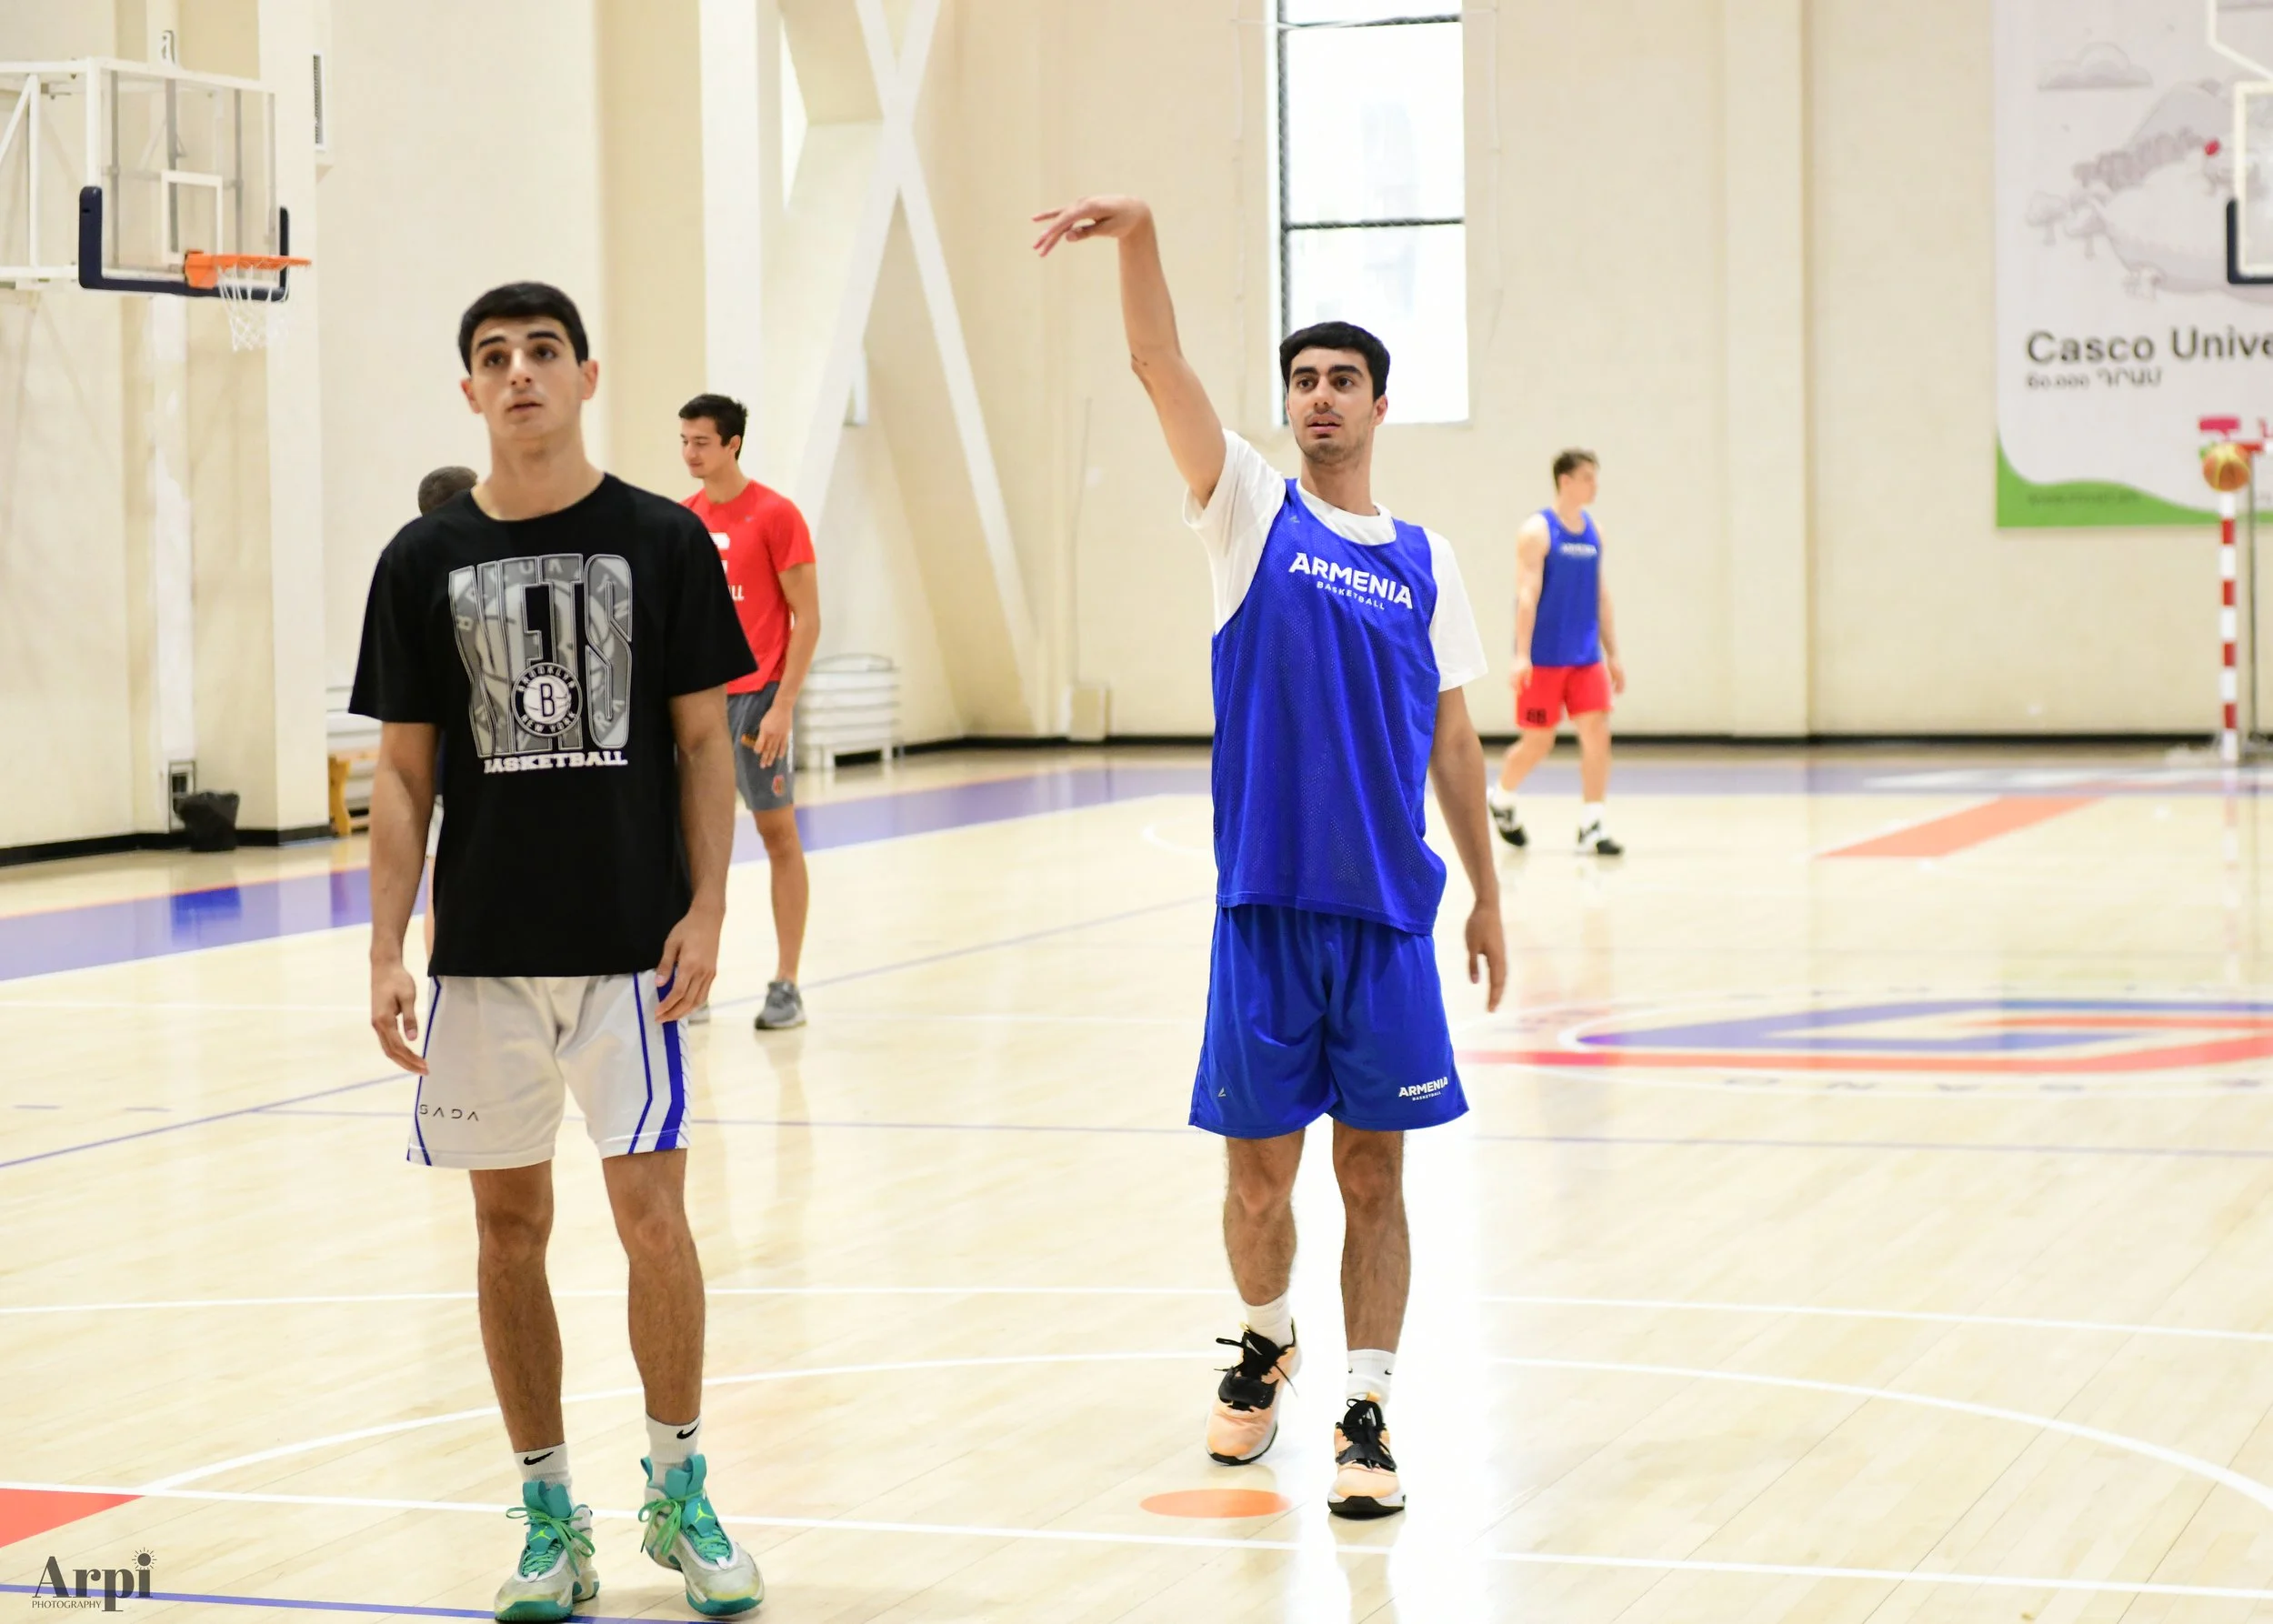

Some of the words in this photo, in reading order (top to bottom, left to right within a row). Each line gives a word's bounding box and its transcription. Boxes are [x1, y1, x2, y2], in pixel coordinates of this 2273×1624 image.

[2027, 330, 2155, 364] Casco
[1288, 552, 1414, 609] ARMENIA
[1316, 580, 1385, 610] BASKETBALL
[448, 553, 633, 757] NETS
[540, 683, 556, 717] B
[1398, 1076, 1449, 1098] ARMENIA
